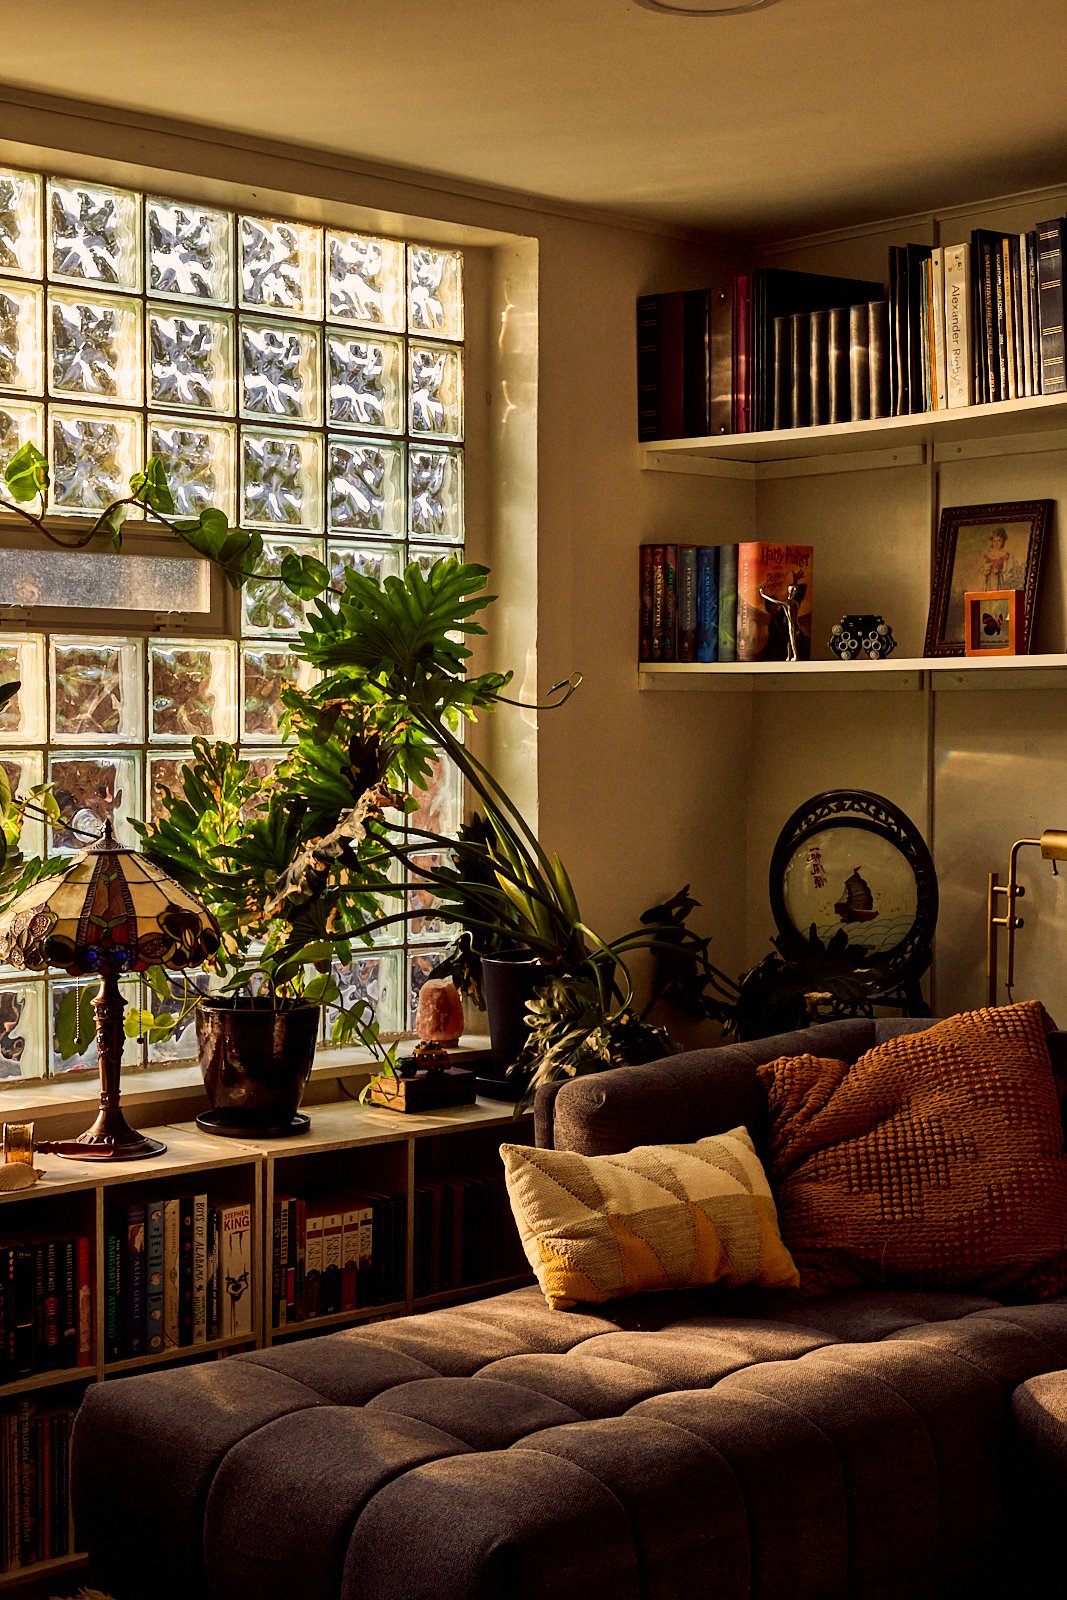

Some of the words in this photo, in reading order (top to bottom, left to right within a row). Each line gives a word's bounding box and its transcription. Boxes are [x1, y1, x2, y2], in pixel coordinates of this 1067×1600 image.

[951, 285, 961, 344] Alexander
[950, 348, 961, 381] Rigby
[761, 546, 785, 566] Harry
[785, 545, 810, 568] Potter
[195, 1202, 205, 1222] BOYS
[224, 1210, 250, 1221] STEPHEN
[224, 1215, 250, 1232] KING
[195, 1226, 204, 1238] OF
[229, 1229, 250, 1257] IT
[107, 1235, 117, 1292] MARGARET
[195, 1241, 204, 1281] ALABAMA
[107, 1295, 116, 1339] ATWOOD
[193, 1296, 202, 1326] HUDSON
